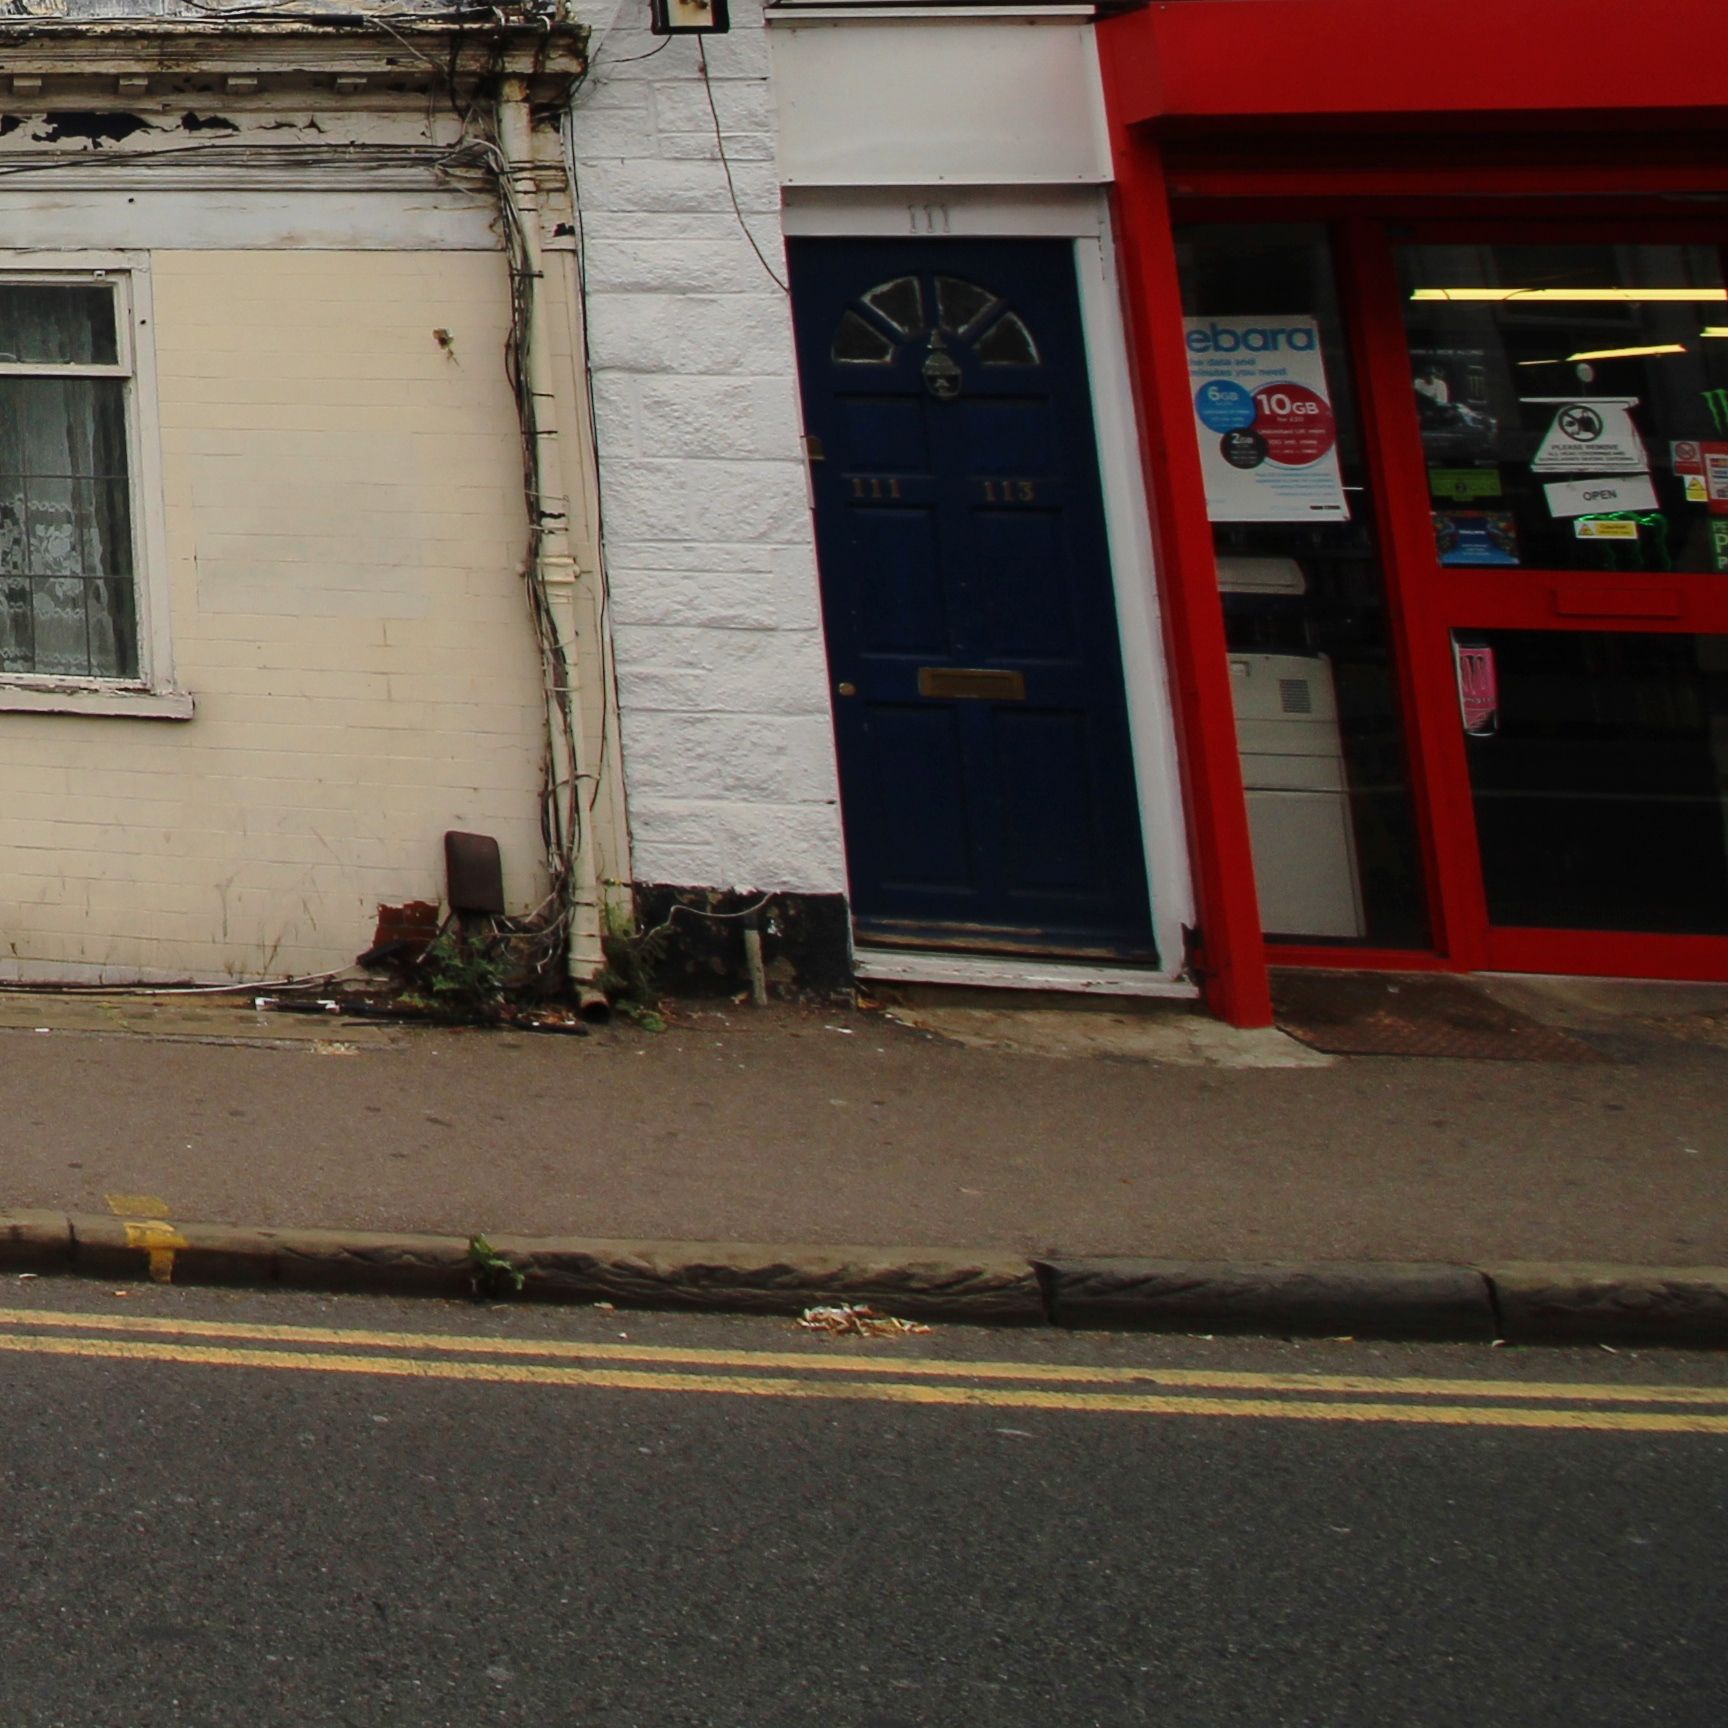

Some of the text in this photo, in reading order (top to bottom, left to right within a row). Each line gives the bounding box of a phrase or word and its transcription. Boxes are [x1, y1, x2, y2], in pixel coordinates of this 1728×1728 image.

[1256, 393, 1320, 415] 10GB
[851, 478, 902, 499] 111
[984, 480, 1037, 502] 113
[1582, 487, 1618, 502] OPEN
